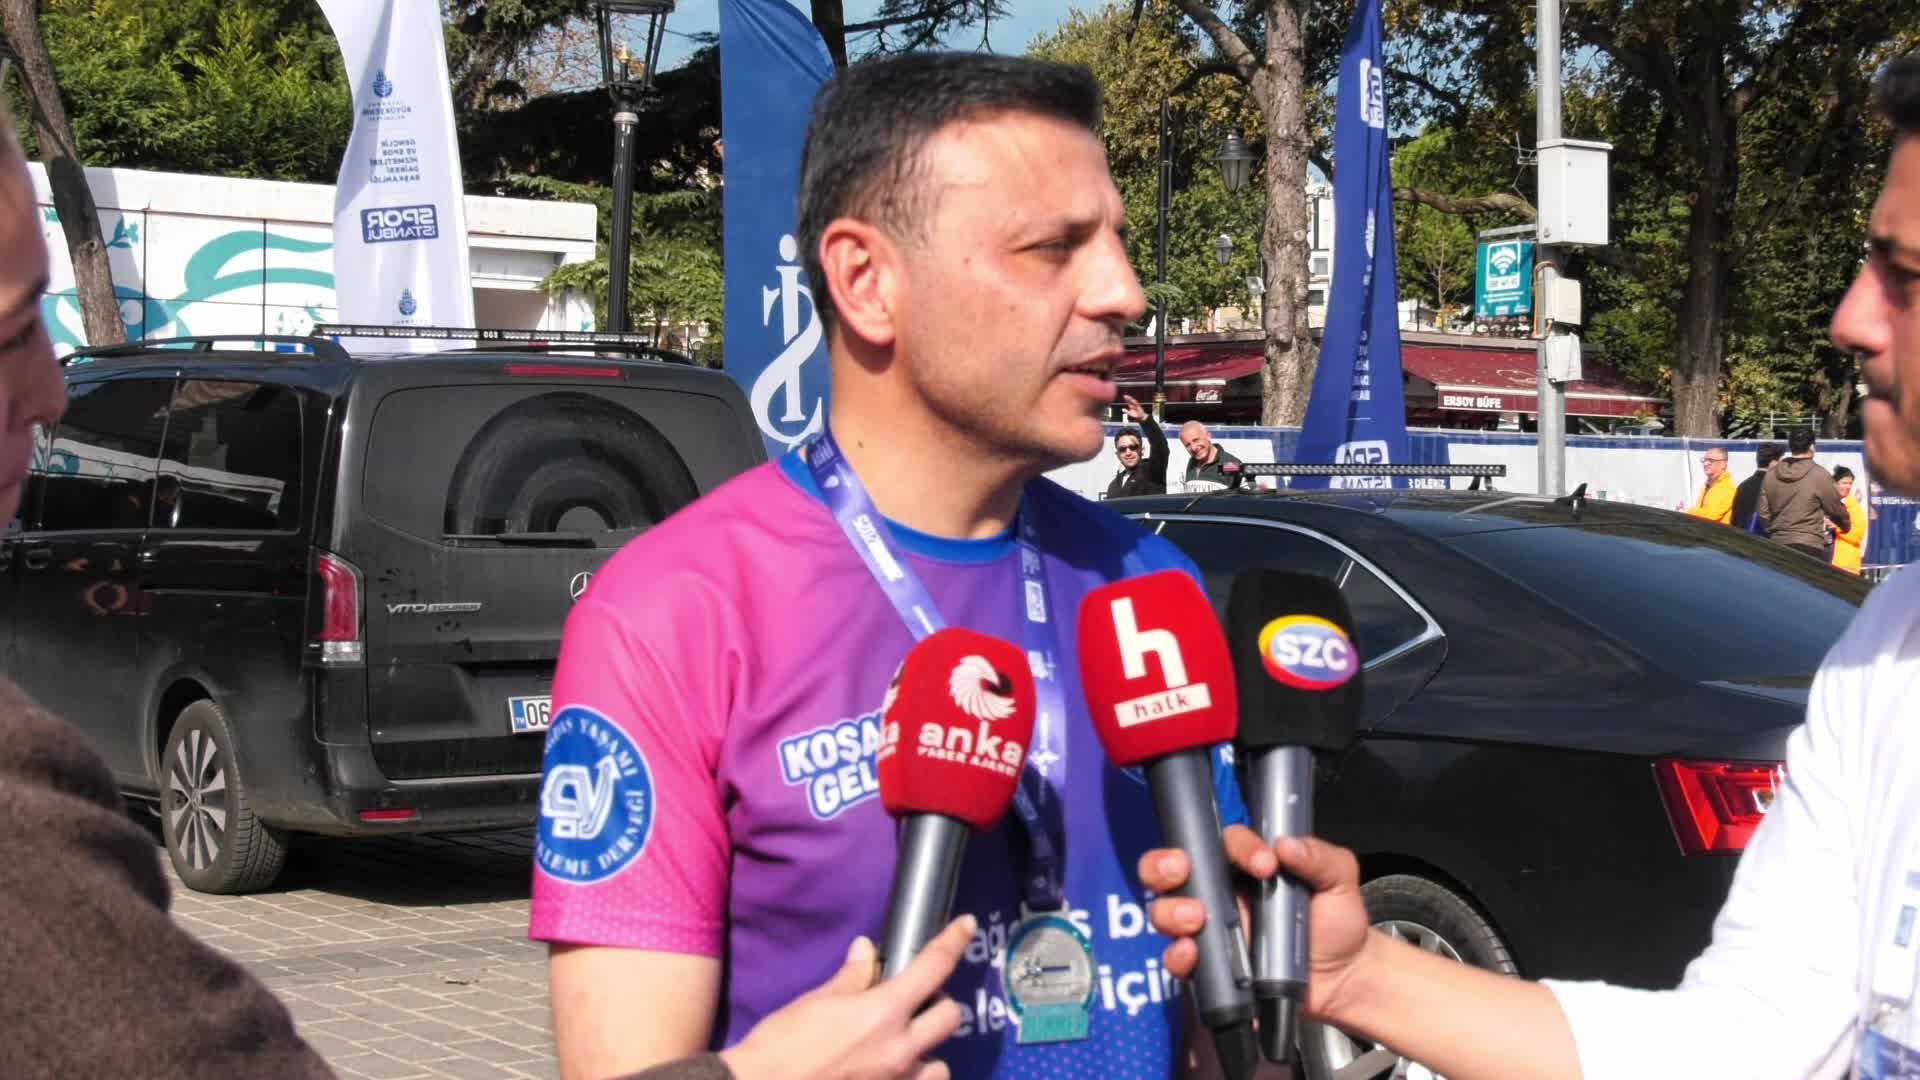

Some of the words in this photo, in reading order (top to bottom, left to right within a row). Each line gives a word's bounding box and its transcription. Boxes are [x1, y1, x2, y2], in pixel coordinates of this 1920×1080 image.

[1443, 395, 1475, 408] ERSOY
[1476, 395, 1502, 409] BÜFE
[1110, 596, 1188, 688] h
[1273, 633, 1348, 671] SZC
[526, 702, 550, 726] 06
[1134, 692, 1191, 719] halk
[919, 720, 1023, 768] anka
